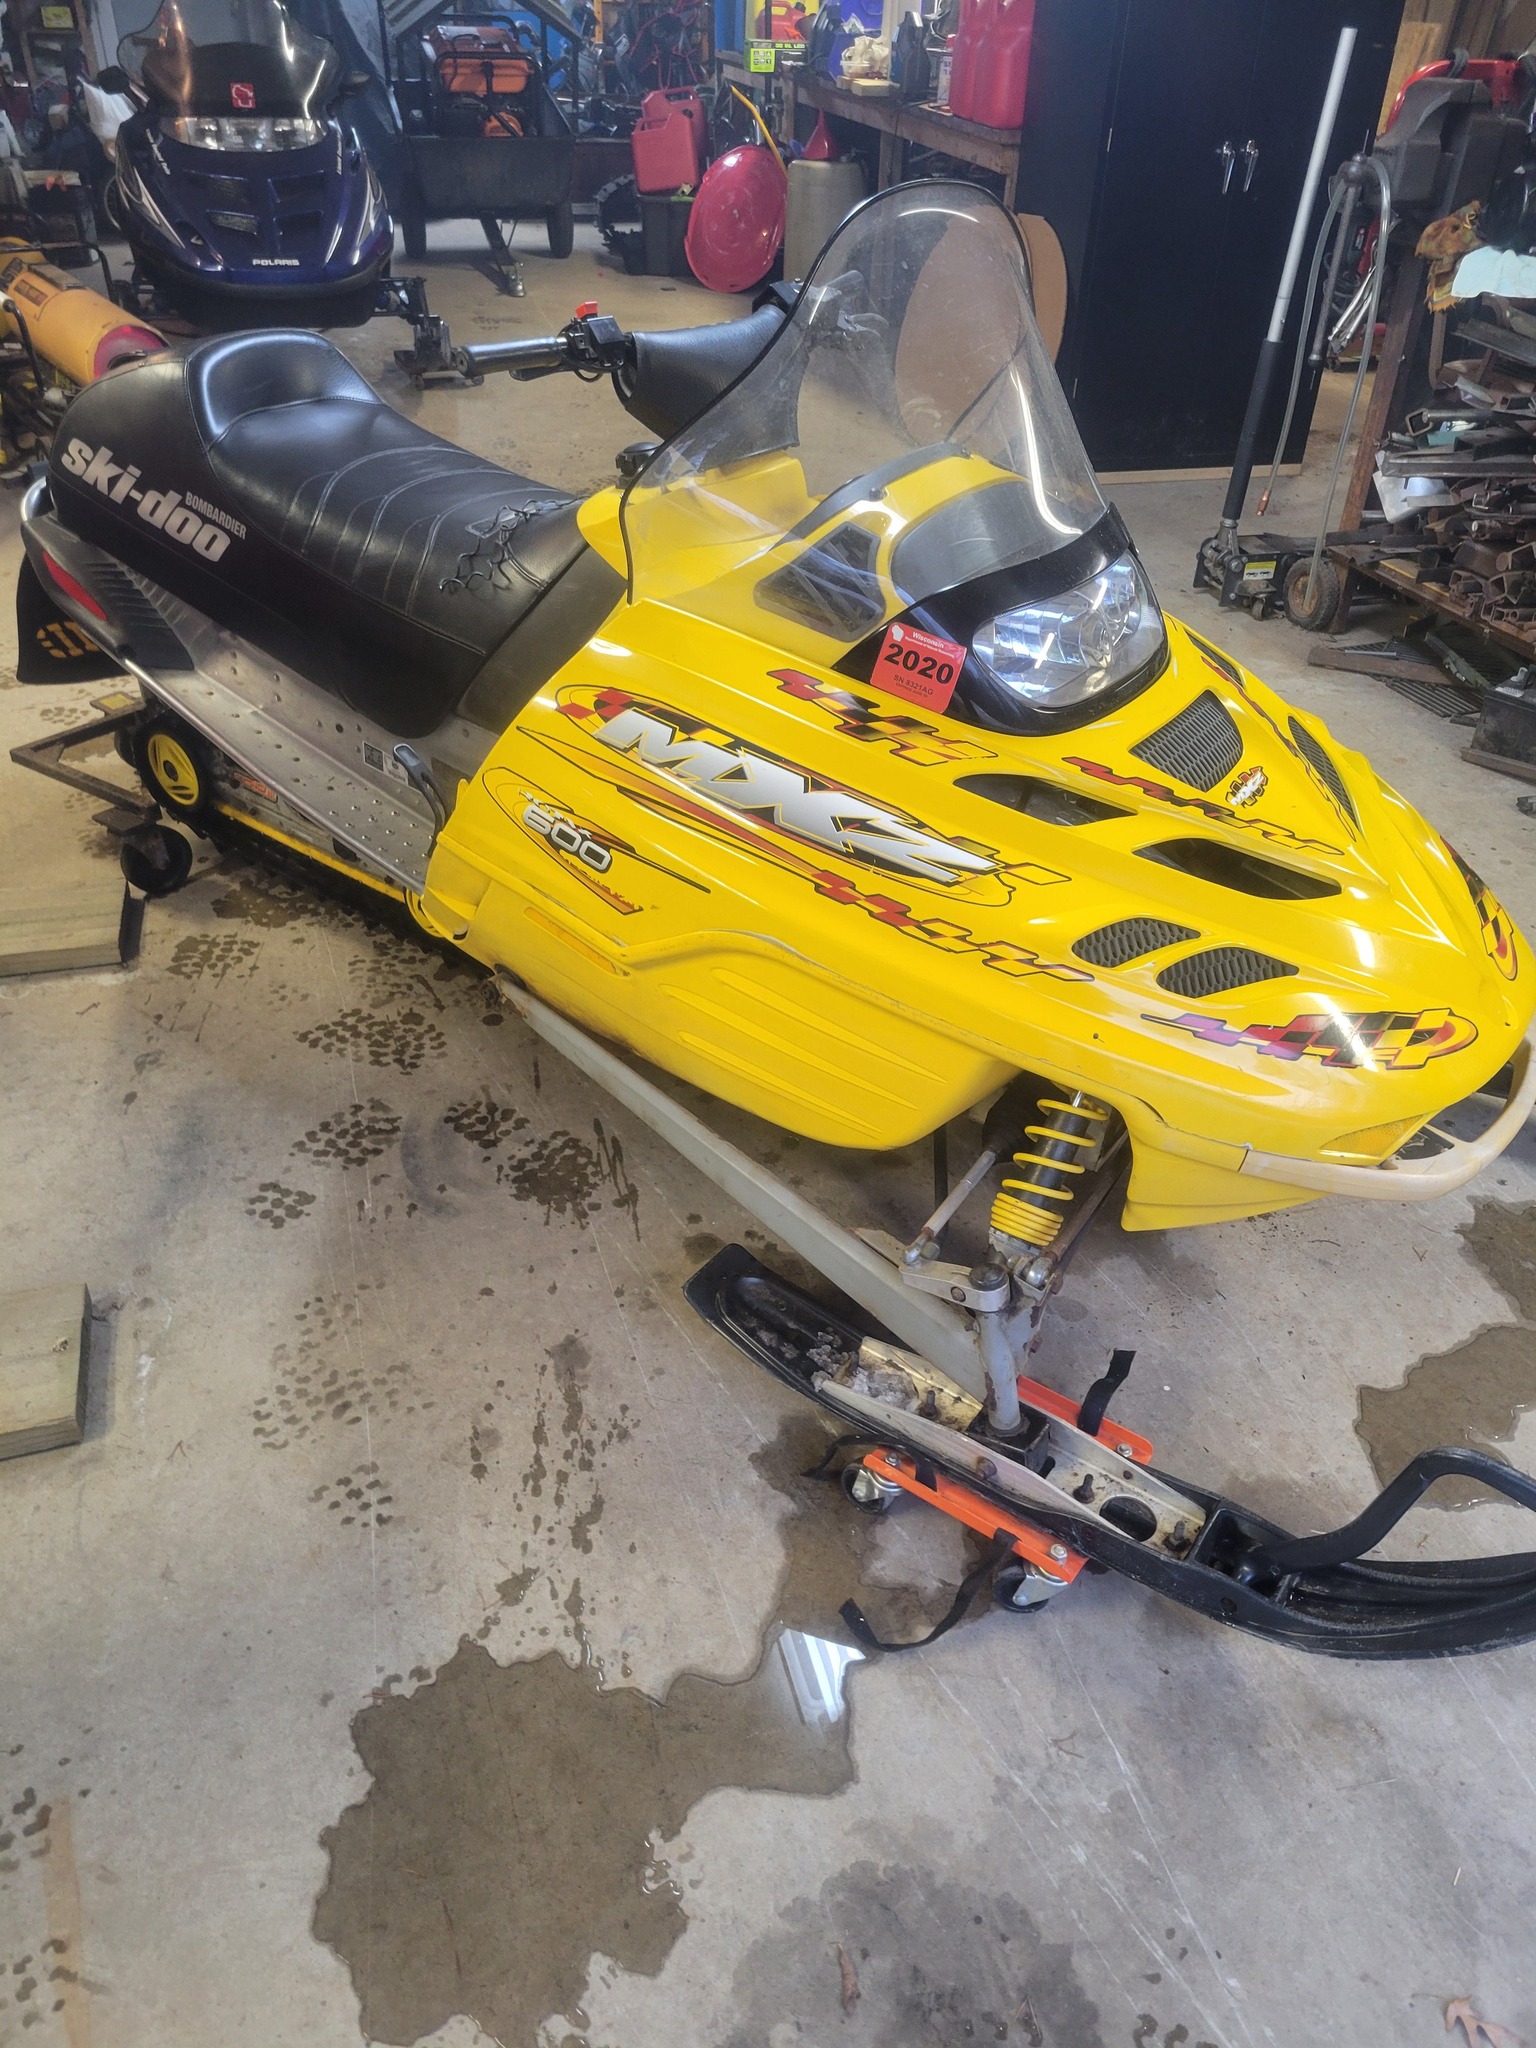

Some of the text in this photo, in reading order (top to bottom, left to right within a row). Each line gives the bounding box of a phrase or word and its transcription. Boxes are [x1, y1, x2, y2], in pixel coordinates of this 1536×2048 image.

[252, 258, 300, 266] POLARIS
[61, 437, 231, 562] ski-doo
[185, 490, 247, 540] BOMBARDIER
[912, 631, 945, 649] Wisconsin
[884, 643, 954, 684] 2020
[893, 674, 934, 696] SN 8321AG
[592, 707, 1004, 887] MXZ
